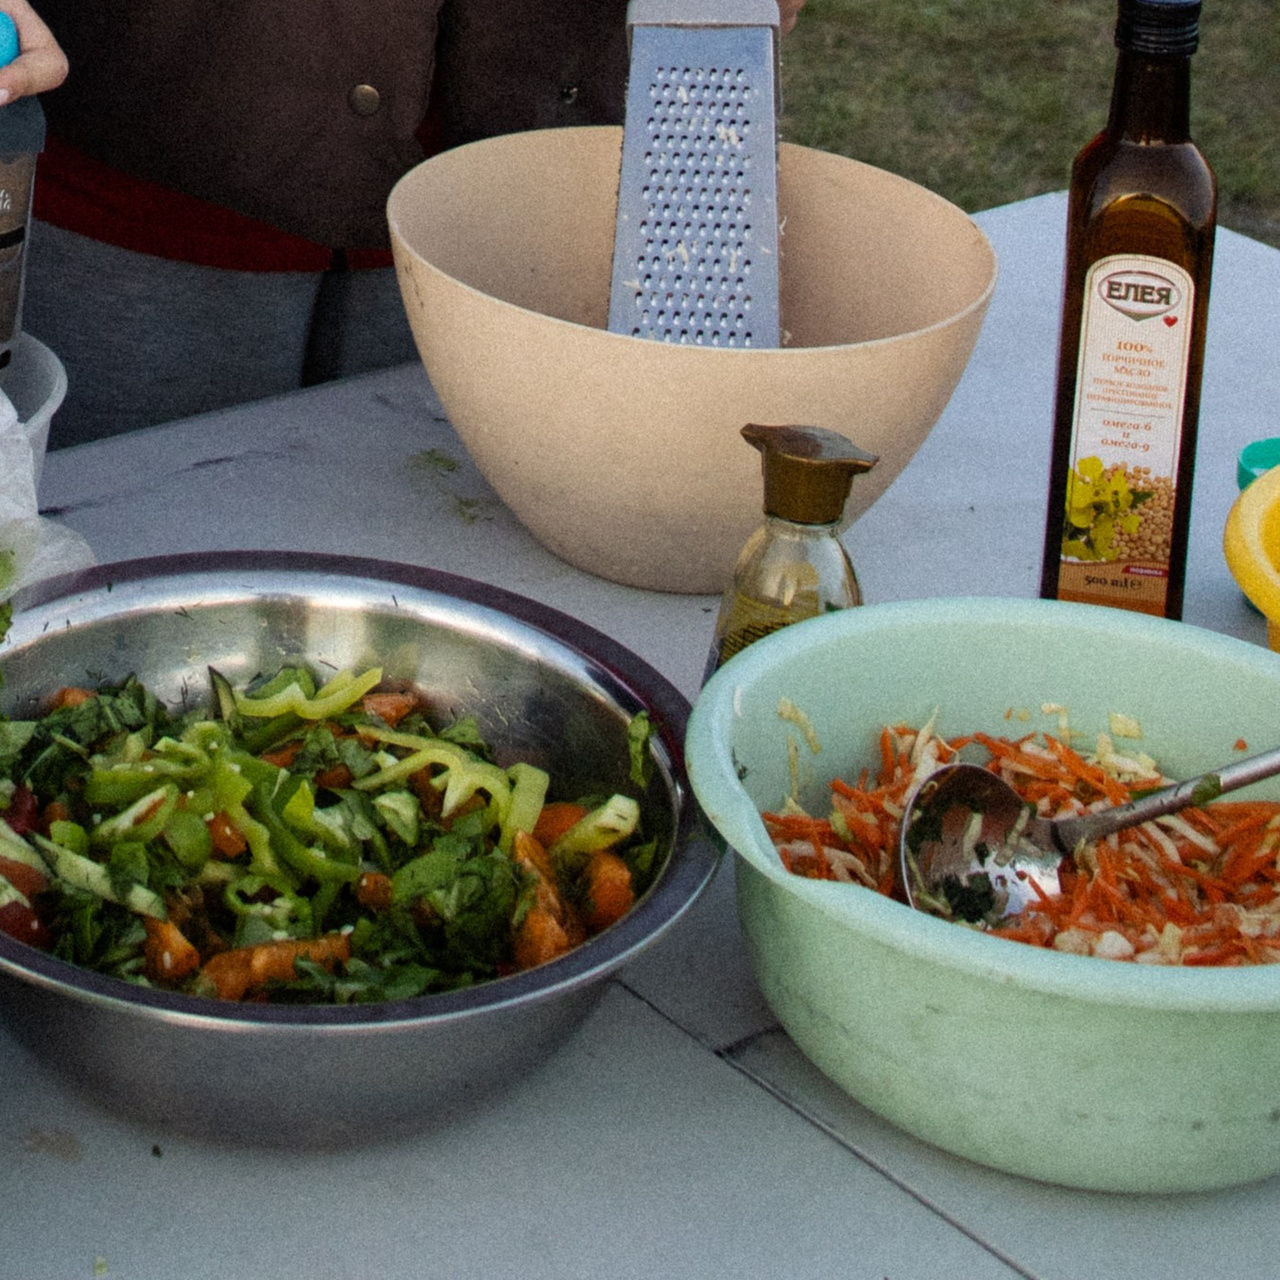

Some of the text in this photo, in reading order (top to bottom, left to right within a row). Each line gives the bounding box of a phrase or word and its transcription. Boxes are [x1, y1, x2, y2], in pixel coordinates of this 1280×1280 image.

[1106, 280, 1172, 306] ЕЛЕЯ
[1116, 341, 1153, 353] 100%
[1101, 439, 1150, 452] омега-9
[1084, 575, 1108, 586] 500
[1111, 577, 1129, 589] ml
